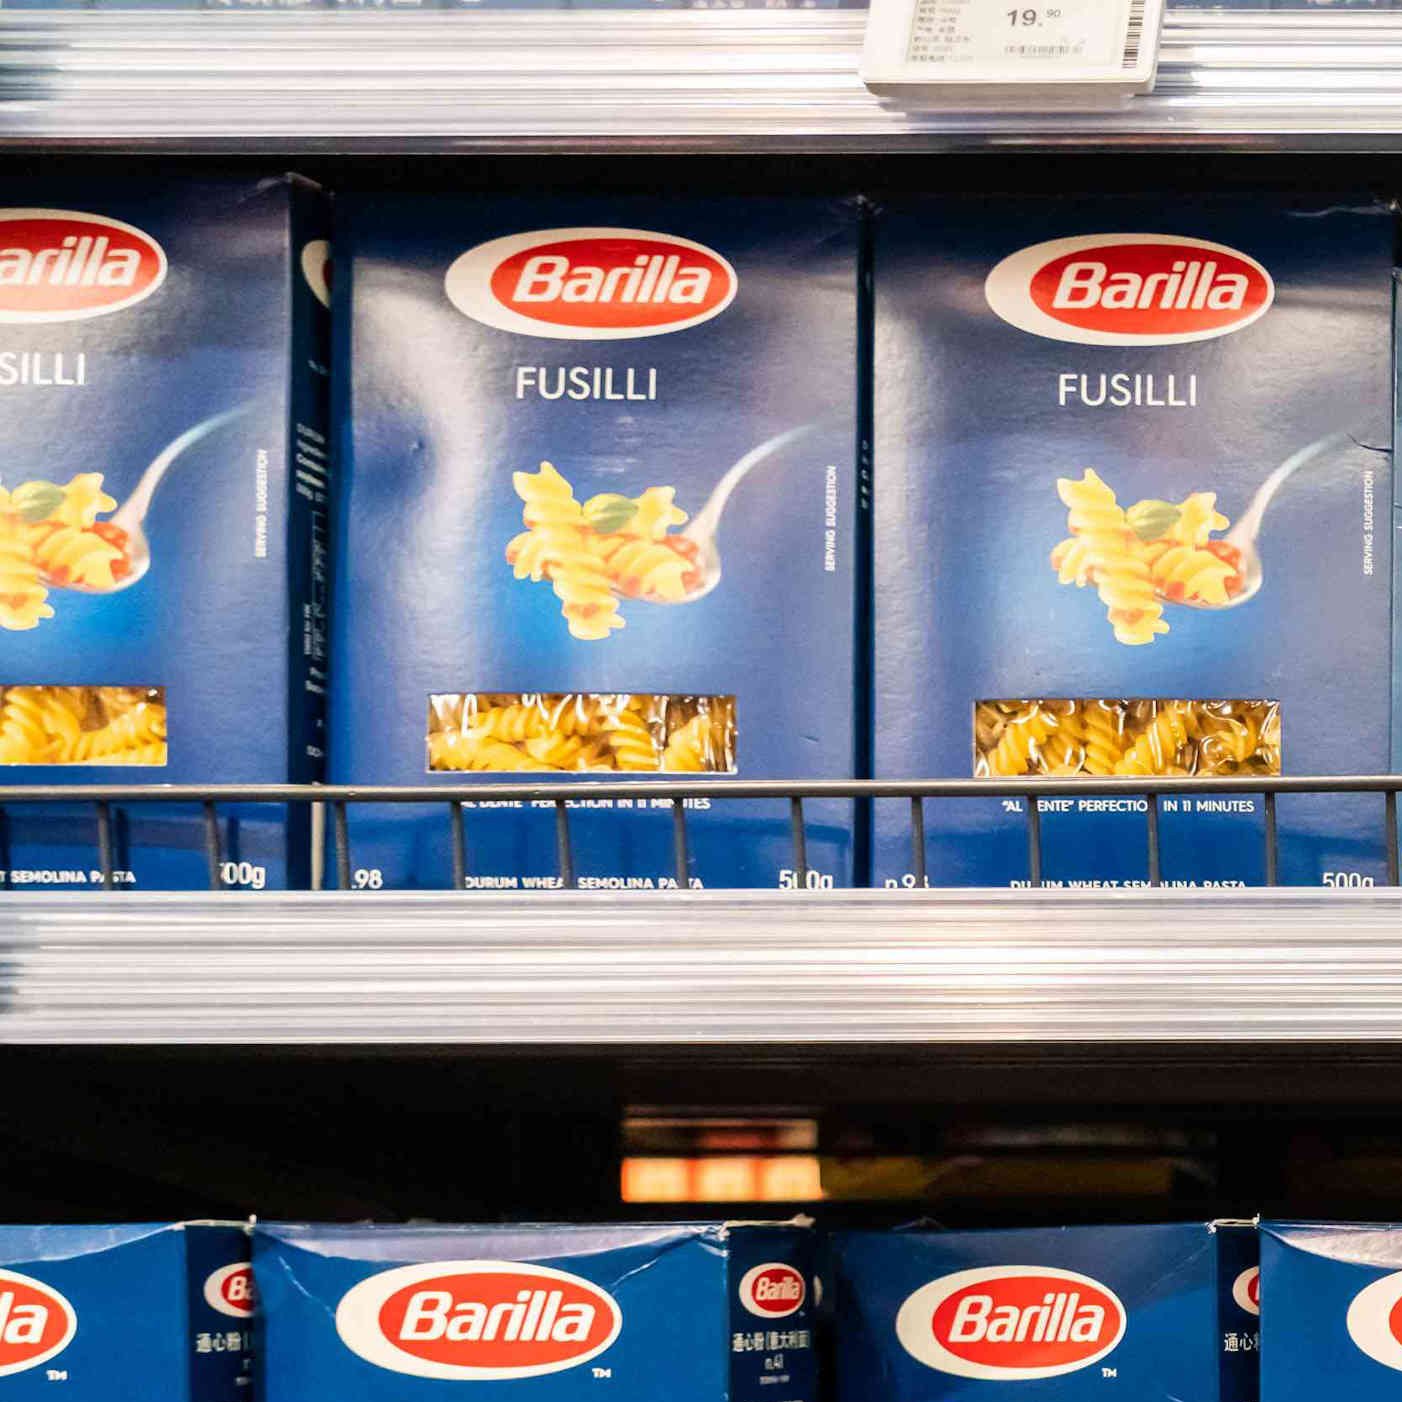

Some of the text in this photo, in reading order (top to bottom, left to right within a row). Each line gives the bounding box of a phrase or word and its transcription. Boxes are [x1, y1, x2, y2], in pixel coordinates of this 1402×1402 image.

[514, 254, 713, 306] Barilla
[1053, 261, 1248, 310] Barilla
[517, 367, 658, 401] FUSILLI
[1058, 374, 1198, 407] FUSILLI
[400, 1291, 595, 1342] Barilla
[947, 1293, 1105, 1343] Barilla
